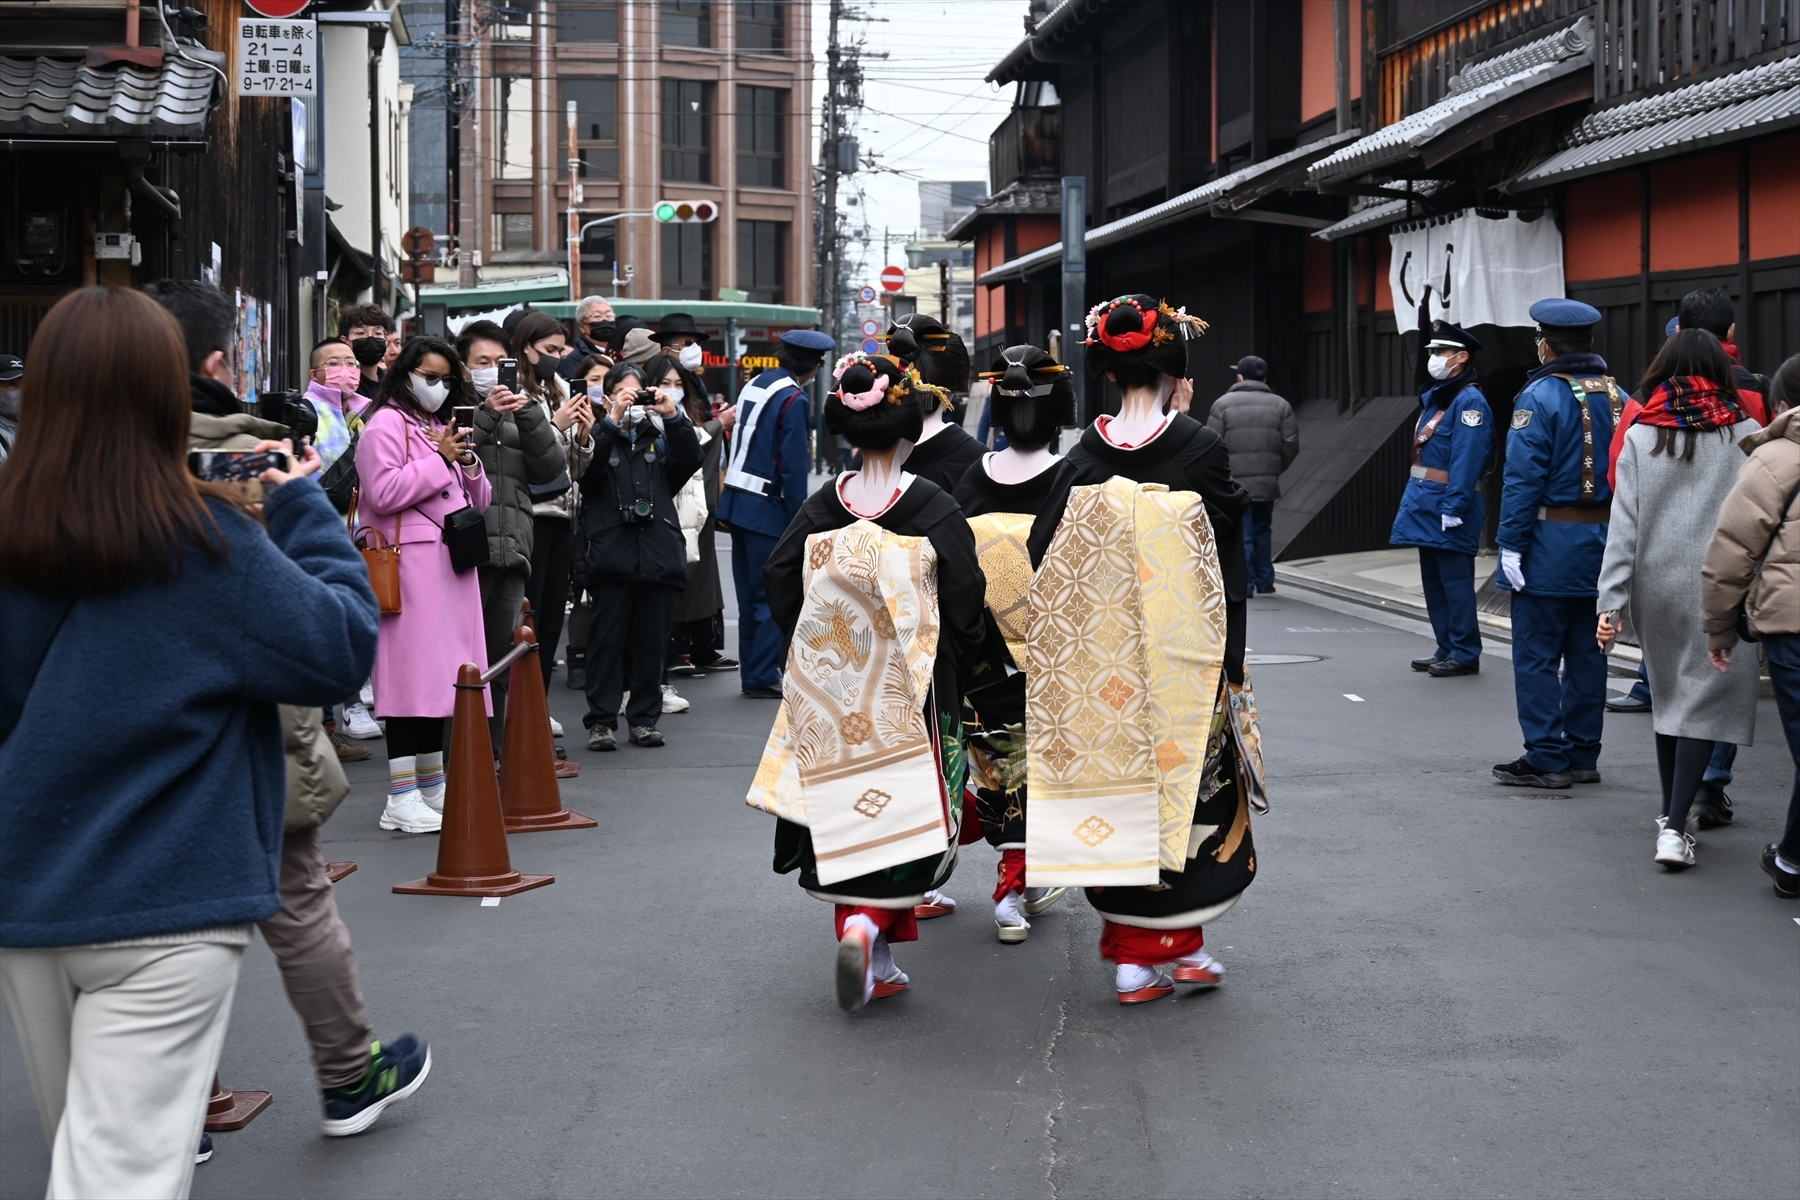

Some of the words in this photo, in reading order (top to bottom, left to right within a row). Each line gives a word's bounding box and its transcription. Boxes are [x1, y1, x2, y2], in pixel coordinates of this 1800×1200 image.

[242, 25, 313, 39] 自転車を除く
[1581, 406, 1594, 493] 交通安全
